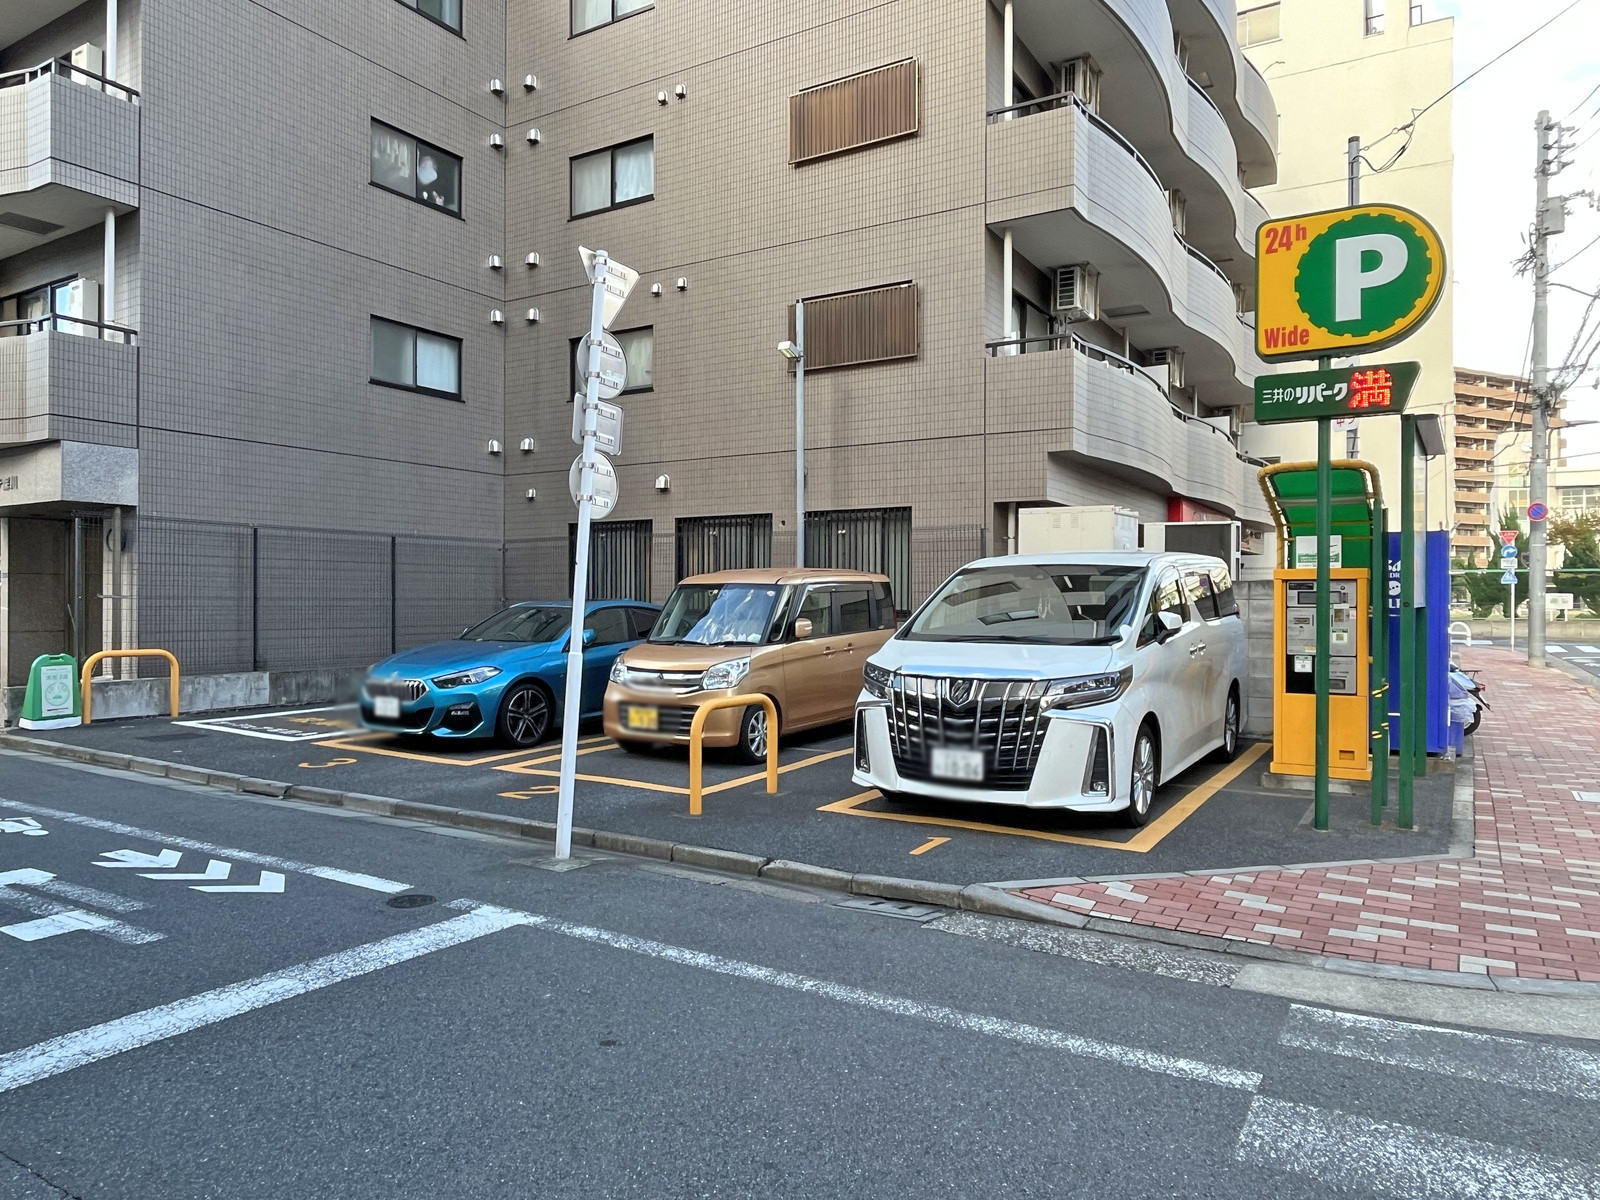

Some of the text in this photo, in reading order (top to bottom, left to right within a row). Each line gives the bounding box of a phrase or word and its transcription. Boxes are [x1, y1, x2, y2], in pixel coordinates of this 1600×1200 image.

[1335, 233, 1409, 322] P
[1264, 325, 1310, 348] Wide
[1262, 383, 1348, 404] 三井のリパーク
[1349, 369, 1393, 409] 満
[298, 758, 357, 768] 3
[496, 785, 560, 799] 2
[909, 836, 952, 856] 1
